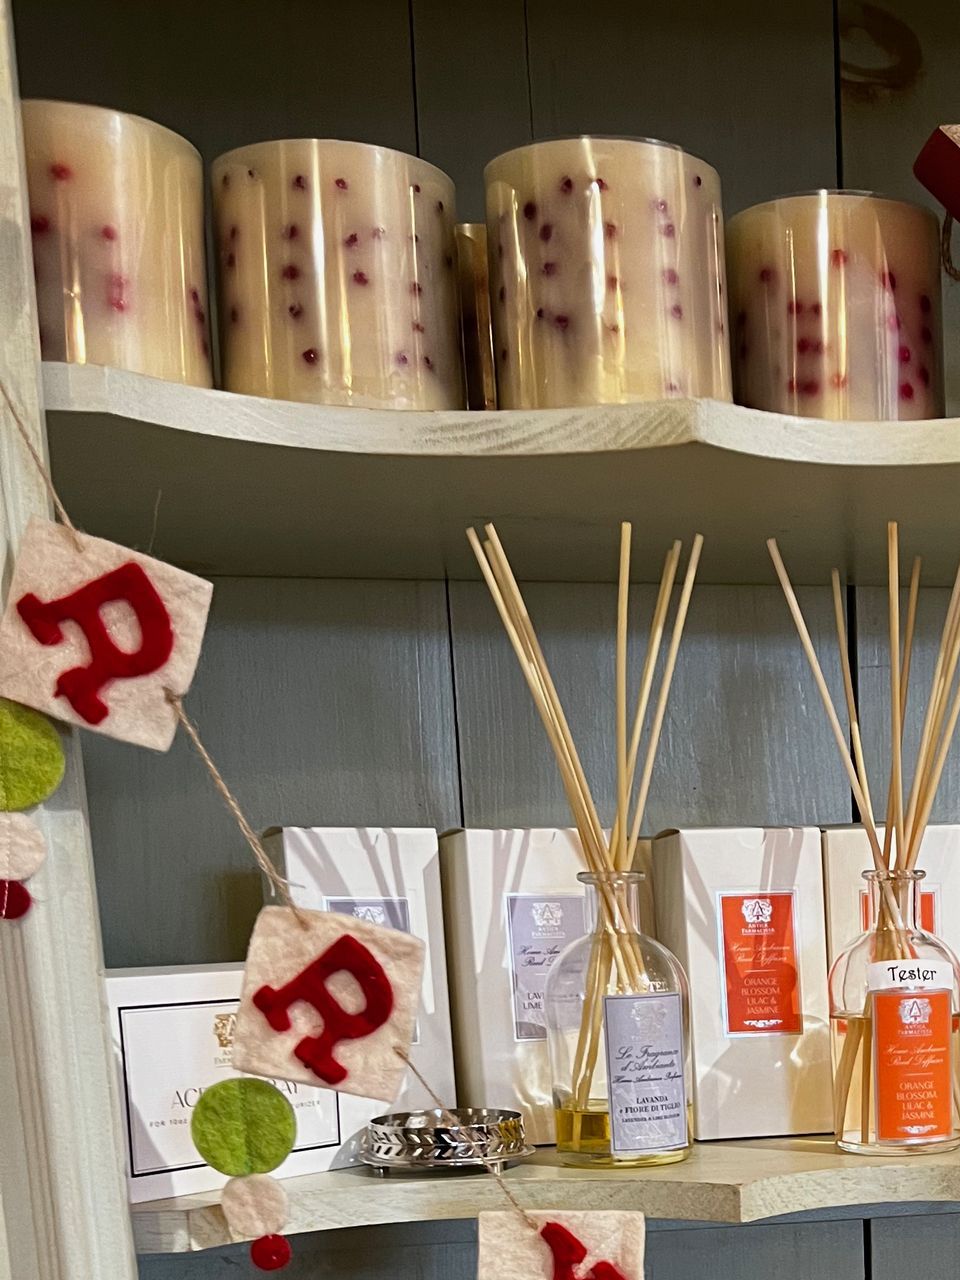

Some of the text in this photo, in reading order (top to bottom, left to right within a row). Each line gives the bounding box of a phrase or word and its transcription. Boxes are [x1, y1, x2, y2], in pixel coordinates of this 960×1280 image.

[887, 965, 937, 983] Tester
[744, 977, 778, 986] ORANGE
[741, 987, 781, 996] BLOSSOM
[746, 996, 767, 1005] LILAC
[746, 1006, 778, 1015] JASMINE
[899, 1081, 934, 1090] ORANGE
[896, 1090, 937, 1101] BLOSSOM
[636, 1096, 669, 1105] LAVANDA
[625, 1106, 650, 1114] FIORE
[661, 1102, 681, 1111] TIGLIO
[902, 1101, 925, 1110] LILAC
[902, 1111, 934, 1120] JASMINE
